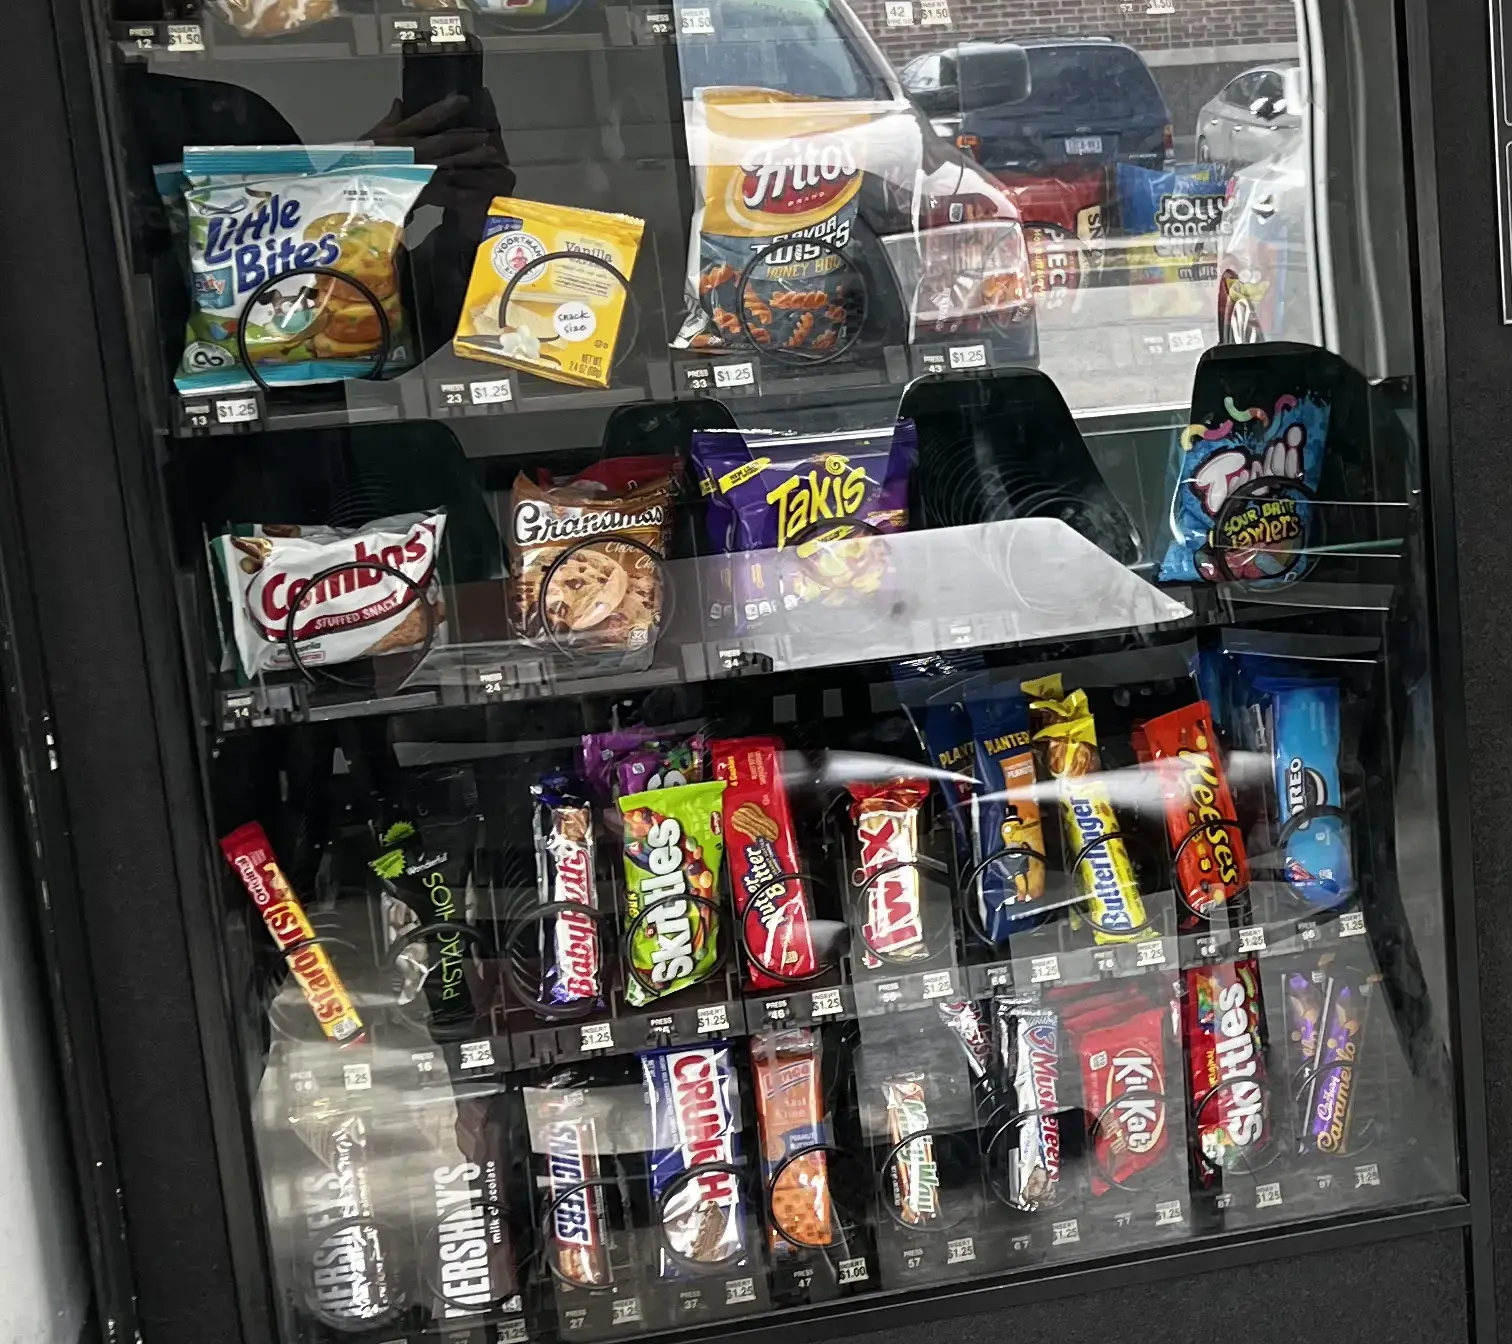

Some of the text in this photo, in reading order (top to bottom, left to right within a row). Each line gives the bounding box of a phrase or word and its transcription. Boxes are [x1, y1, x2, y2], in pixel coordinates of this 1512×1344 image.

[889, 5, 905, 17] 42
[921, 8, 949, 20] $1.50
[431, 23, 463, 37] $1.50
[136, 38, 152, 49] 12
[168, 33, 200, 47] $1.50
[741, 138, 858, 207] Fritos
[204, 195, 302, 265] Little
[235, 232, 341, 294] Bites
[950, 348, 986, 366] $1.25
[692, 367, 752, 389] 33 $1.25
[446, 382, 511, 404] 23 $1.25
[190, 400, 257, 426] 13 $1.25
[766, 454, 866, 553] Takis
[1224, 509, 1258, 536] SOUR
[261, 529, 427, 622] Combos
[315, 612, 361, 630] STUFFED
[723, 657, 740, 668] 34
[485, 682, 502, 693] 24
[1287, 757, 1306, 830] OREO
[641, 817, 694, 984] Skittles
[1340, 919, 1365, 933] $1.25
[1239, 935, 1264, 948] $1.25
[1137, 947, 1162, 960] $1.25
[1032, 966, 1058, 979] $1.25
[923, 981, 951, 995] $1.25
[812, 998, 840, 1012] $1.25
[698, 1014, 727, 1028] $1.25
[582, 1031, 611, 1045] $1.25
[1028, 1027, 1056, 1050] 3
[461, 1050, 491, 1064] $1.25
[417, 1062, 432, 1072] 16
[1216, 983, 1264, 1146] Skittles
[549, 1123, 592, 1246] SNICKERS
[1355, 1172, 1379, 1185] $1.25
[1256, 1190, 1282, 1203] $1.25
[1116, 1216, 1132, 1226] 77
[1156, 1210, 1182, 1223] $1.25
[491, 1218, 504, 1245] milk
[1053, 1227, 1079, 1240] $1.25
[948, 1246, 974, 1259] $1.25
[907, 1257, 921, 1268] 57
[839, 1265, 866, 1279] $1.00
[797, 1277, 811, 1288] 47
[727, 1286, 754, 1299] $1.25
[569, 1318, 585, 1329] 27
[499, 1326, 526, 1339] $1.25
